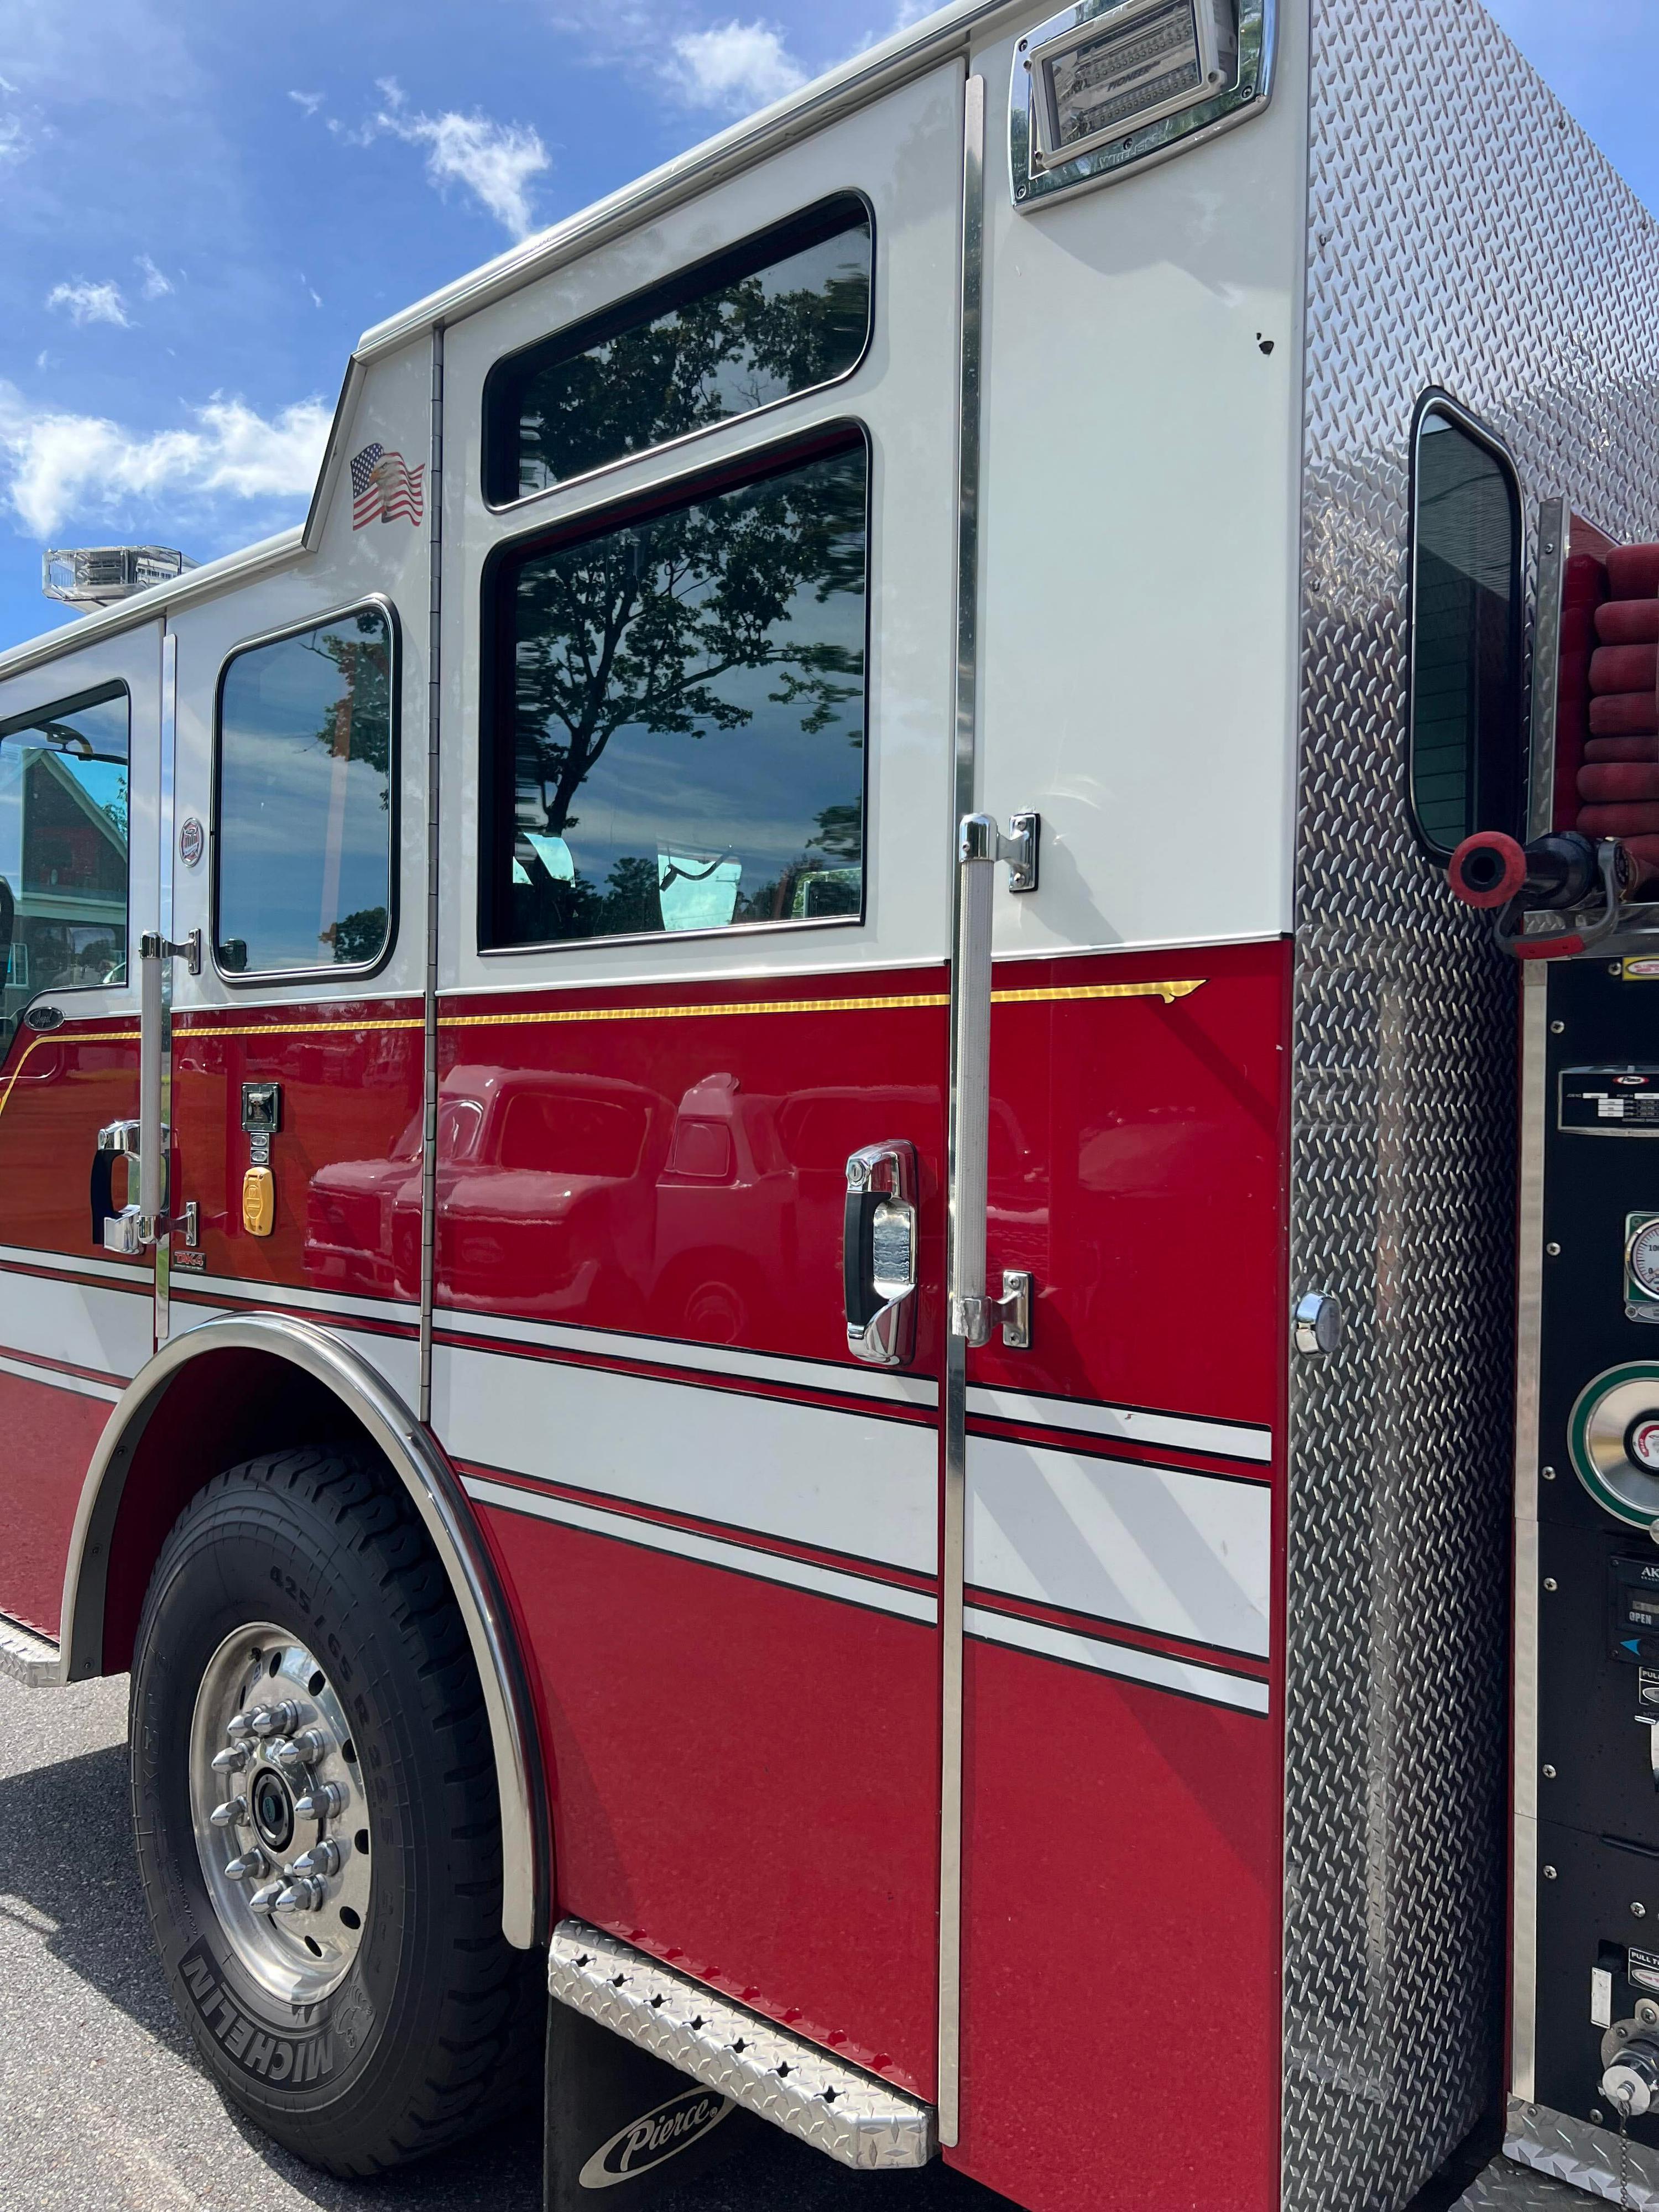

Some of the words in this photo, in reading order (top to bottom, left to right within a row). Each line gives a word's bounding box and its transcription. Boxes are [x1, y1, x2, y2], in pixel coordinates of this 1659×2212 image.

[1629, 1611, 1652, 1626] OPEN
[1642, 1670, 1659, 1679] PUL
[1631, 1951, 1651, 1964] PULL
[182, 1954, 333, 2083] MICHELIN
[620, 2099, 709, 2172] Pierce
